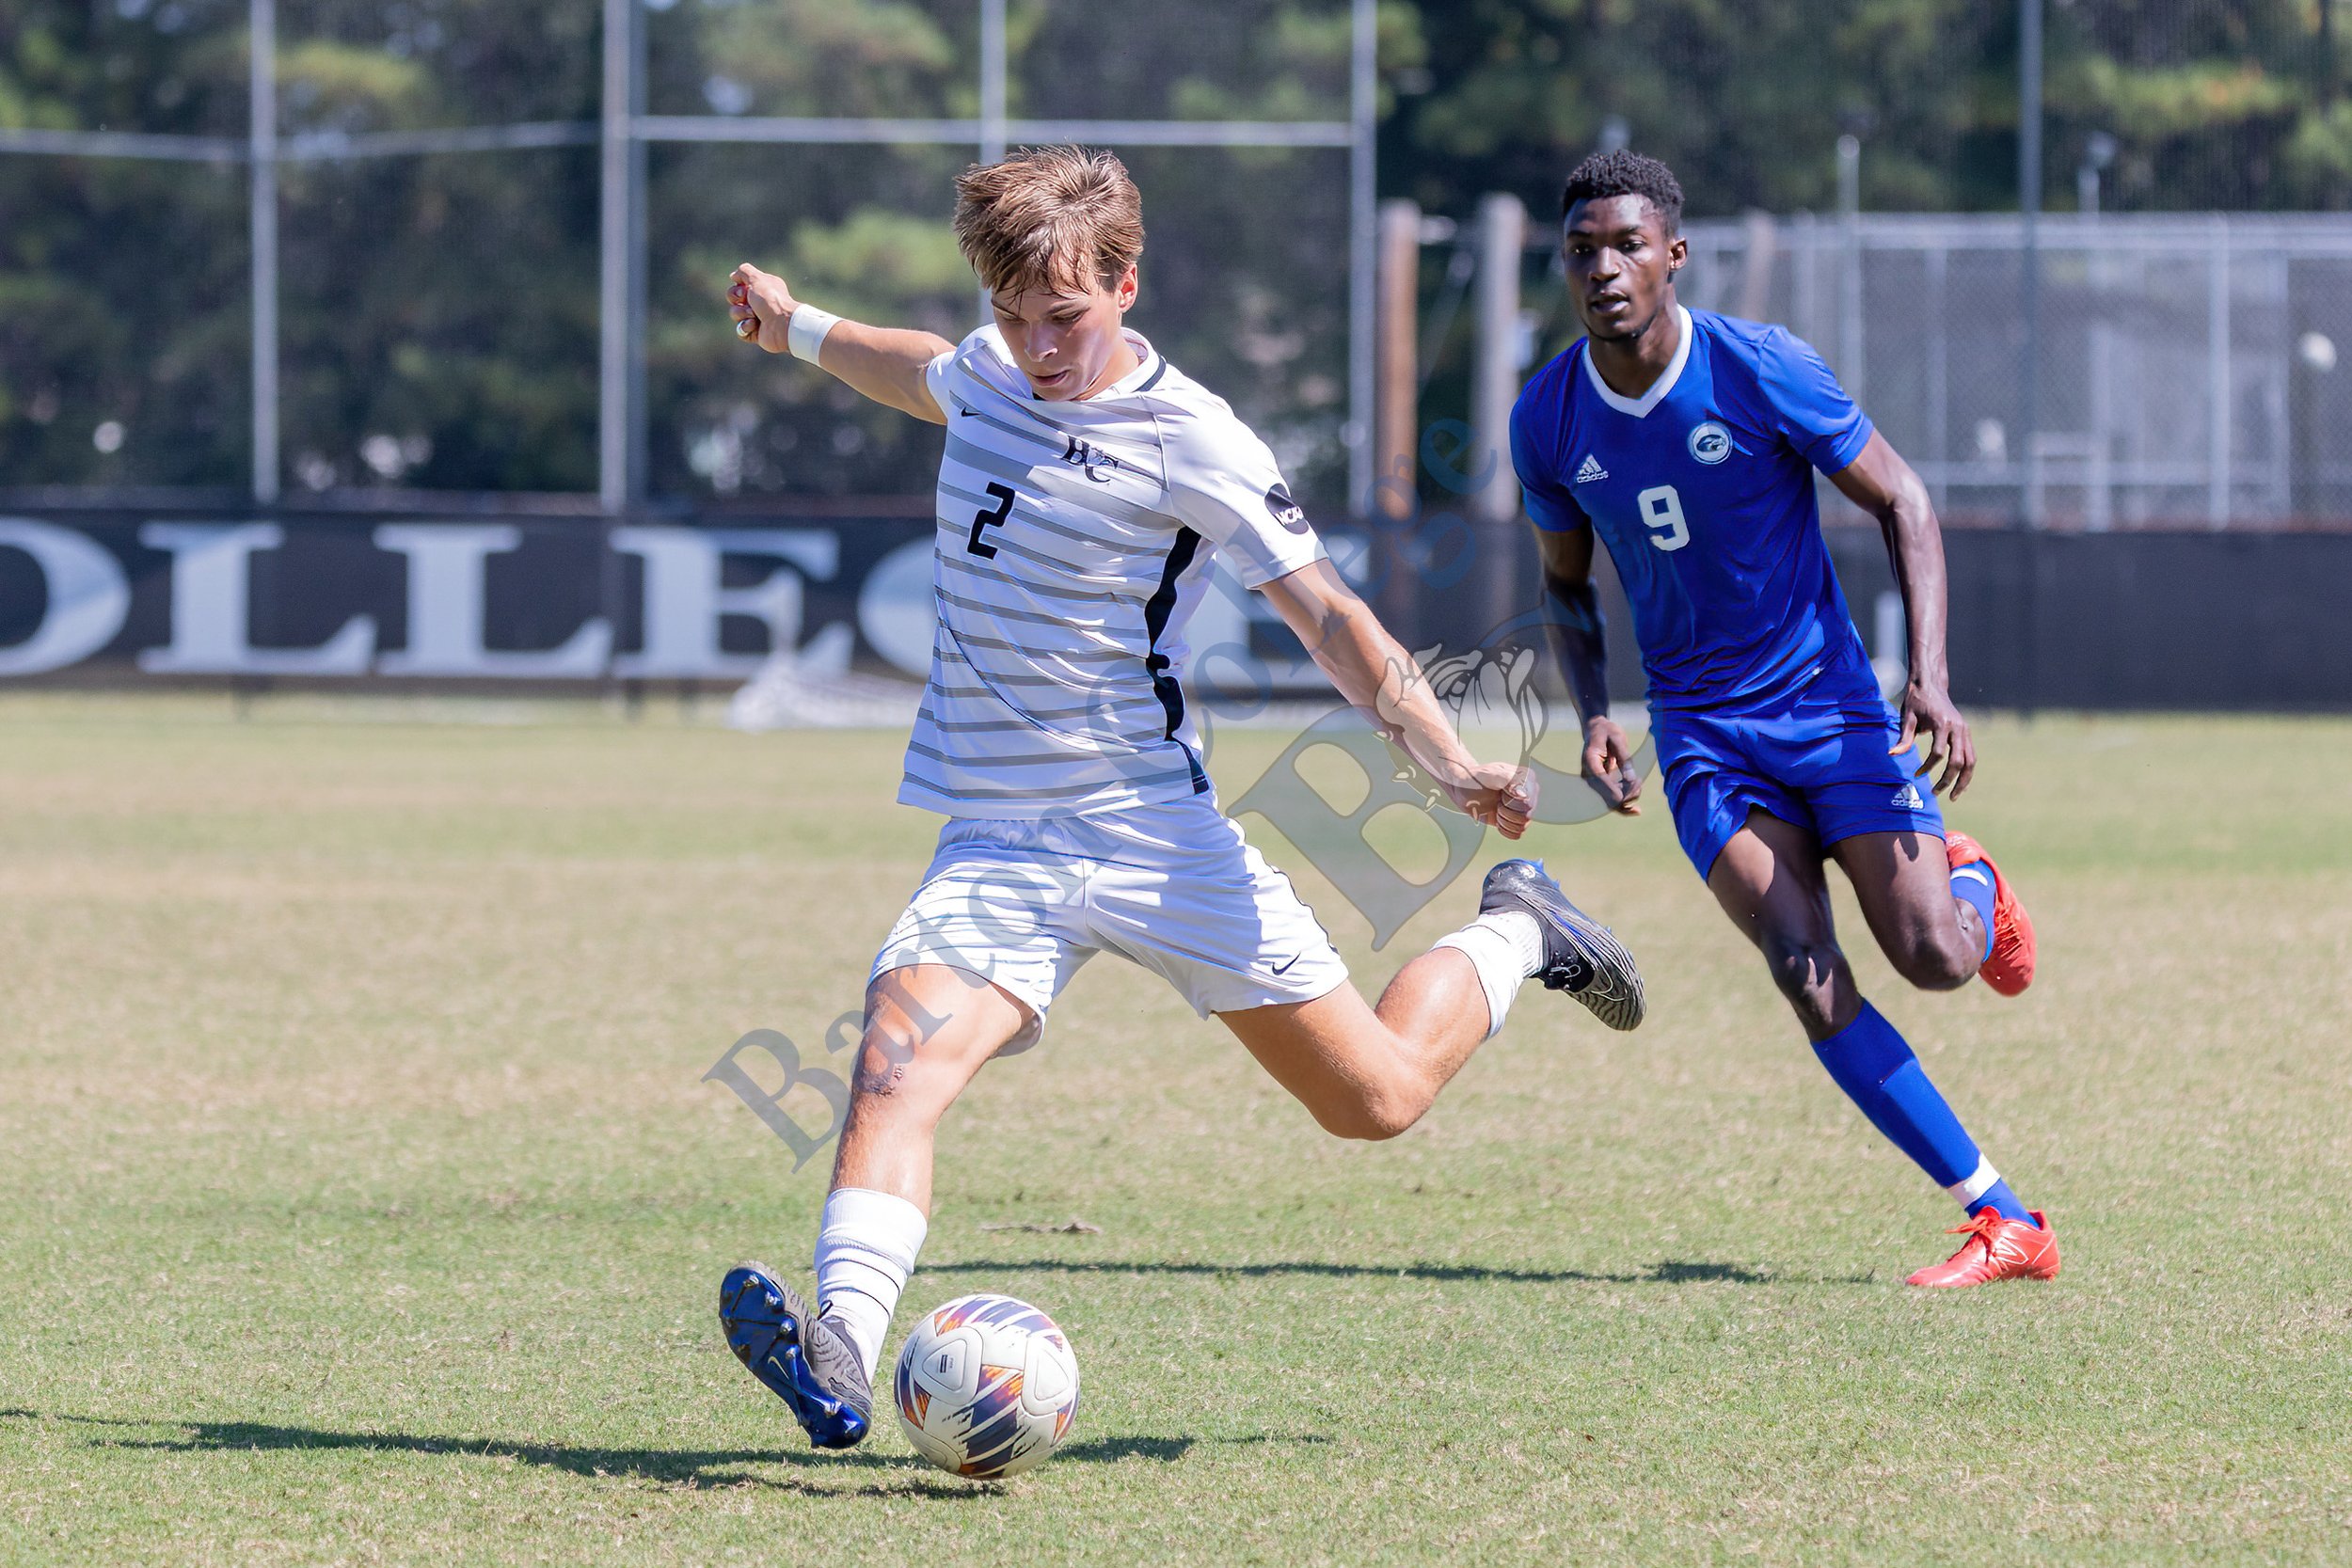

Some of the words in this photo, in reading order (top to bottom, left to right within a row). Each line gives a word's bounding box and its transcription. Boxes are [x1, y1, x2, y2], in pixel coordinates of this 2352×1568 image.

[1576, 469, 1609, 483] adidas
[967, 482, 1015, 560] 2
[1638, 484, 1690, 551] 9
